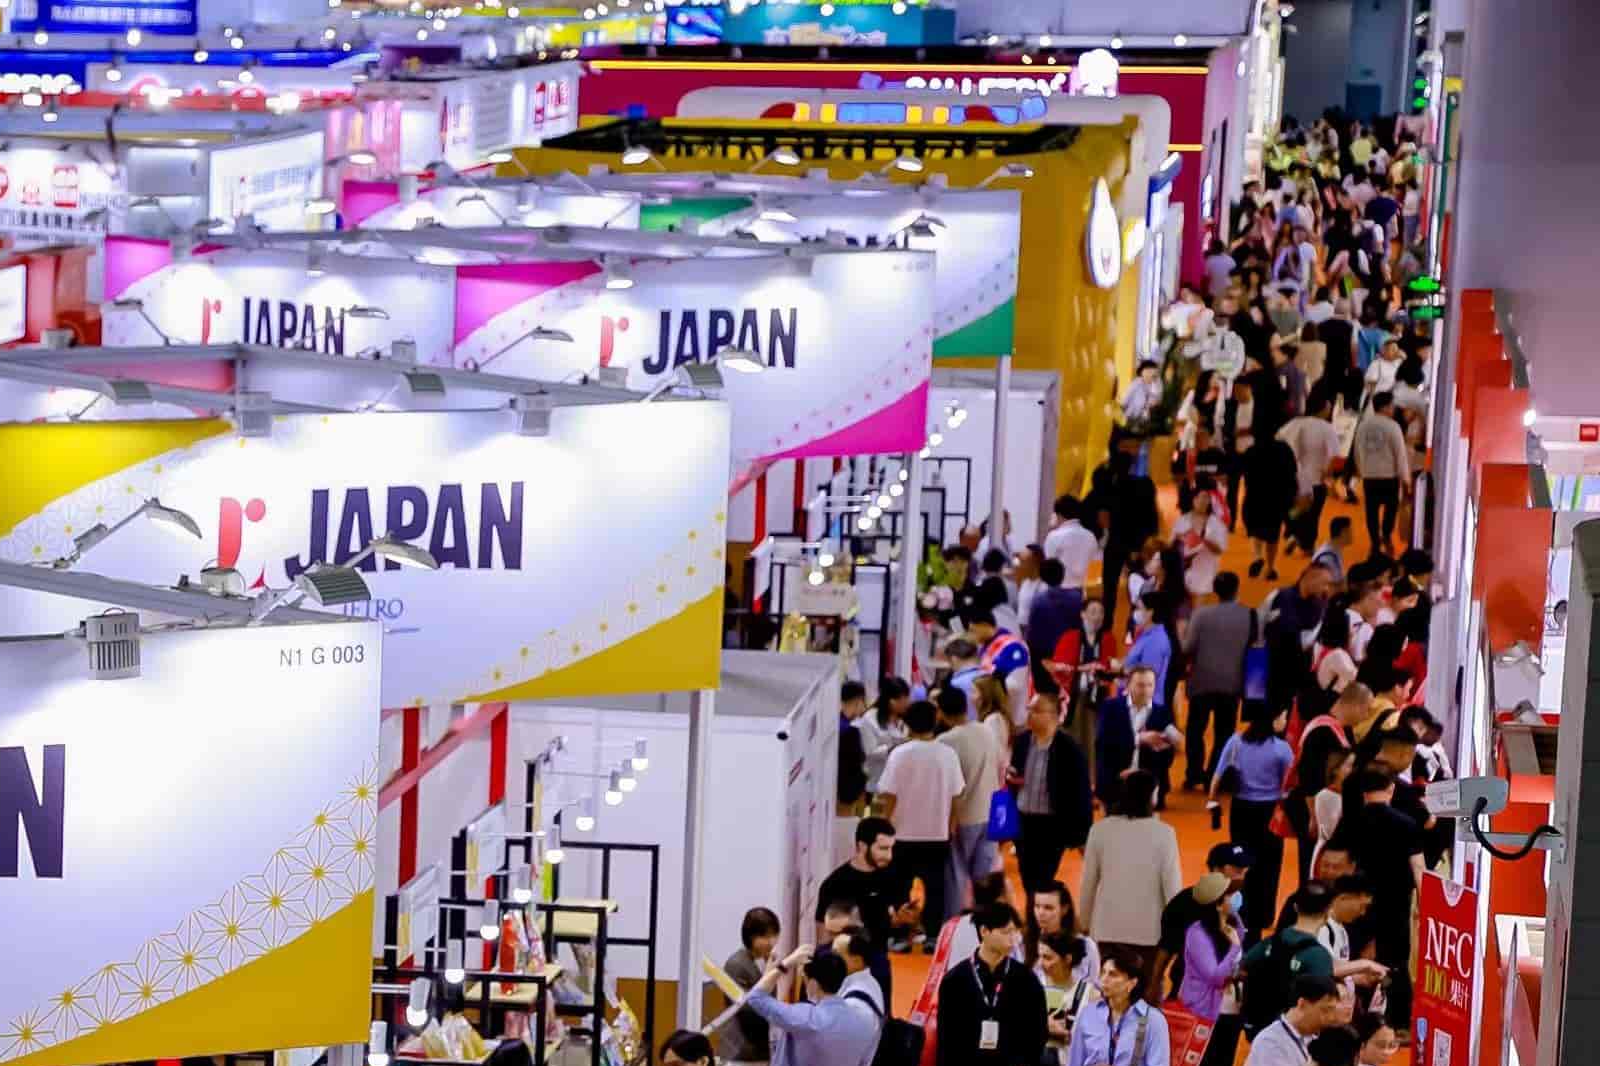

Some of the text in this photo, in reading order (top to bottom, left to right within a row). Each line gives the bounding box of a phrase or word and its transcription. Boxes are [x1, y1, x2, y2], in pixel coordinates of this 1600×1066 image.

[243, 296, 345, 355] JAPAN
[642, 308, 797, 375] JAPAN
[284, 481, 525, 582] JAPAN
[280, 645, 365, 666] N1 G 003
[1424, 916, 1473, 979] NFC
